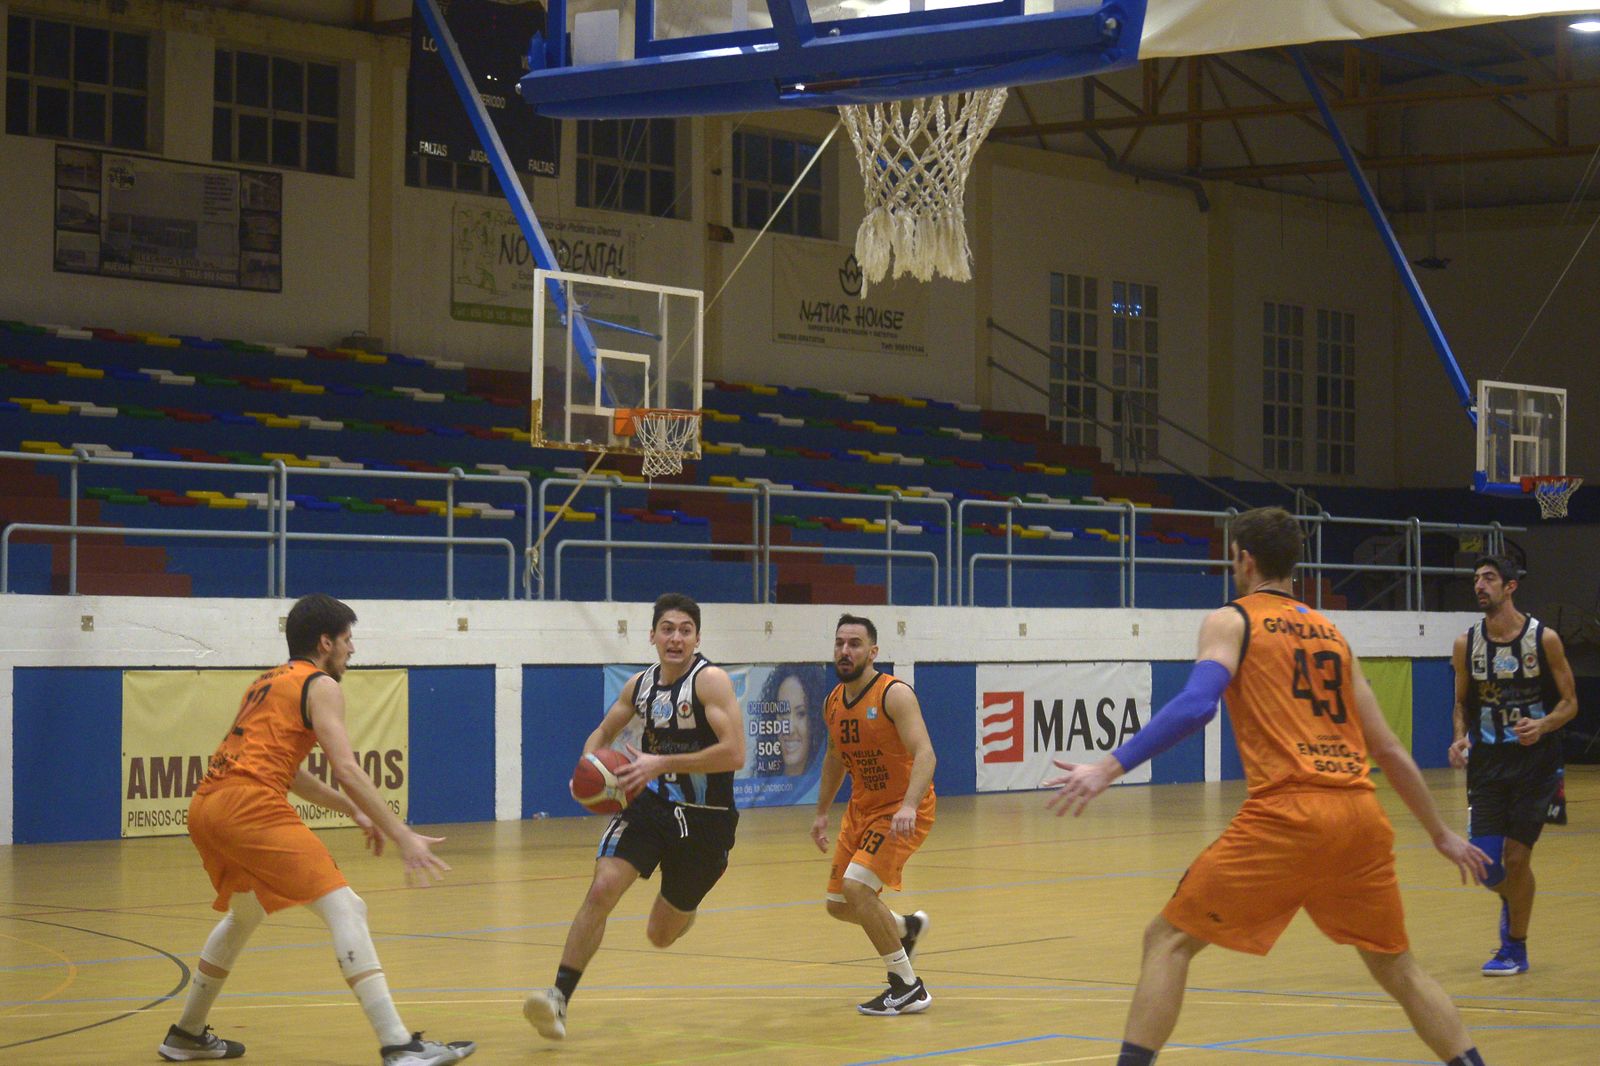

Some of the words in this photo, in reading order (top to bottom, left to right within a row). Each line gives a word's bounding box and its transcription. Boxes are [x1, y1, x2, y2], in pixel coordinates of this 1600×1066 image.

[480, 94, 506, 109] ERIODO
[419, 141, 448, 157] FALTAS
[528, 158, 555, 174] FALTAS
[799, 299, 851, 325] NATUR
[854, 305, 905, 331] HOUSE
[1263, 616, 1341, 643] GONZALE
[1292, 648, 1347, 723] 43
[1033, 697, 1142, 752] MASA
[1499, 706, 1522, 727] 14
[749, 720, 790, 735] DESDE
[839, 719, 860, 744] 33
[758, 742, 781, 756] 50€
[757, 762, 767, 772] AL
[856, 758, 878, 766] PORT
[858, 828, 885, 855] 33
